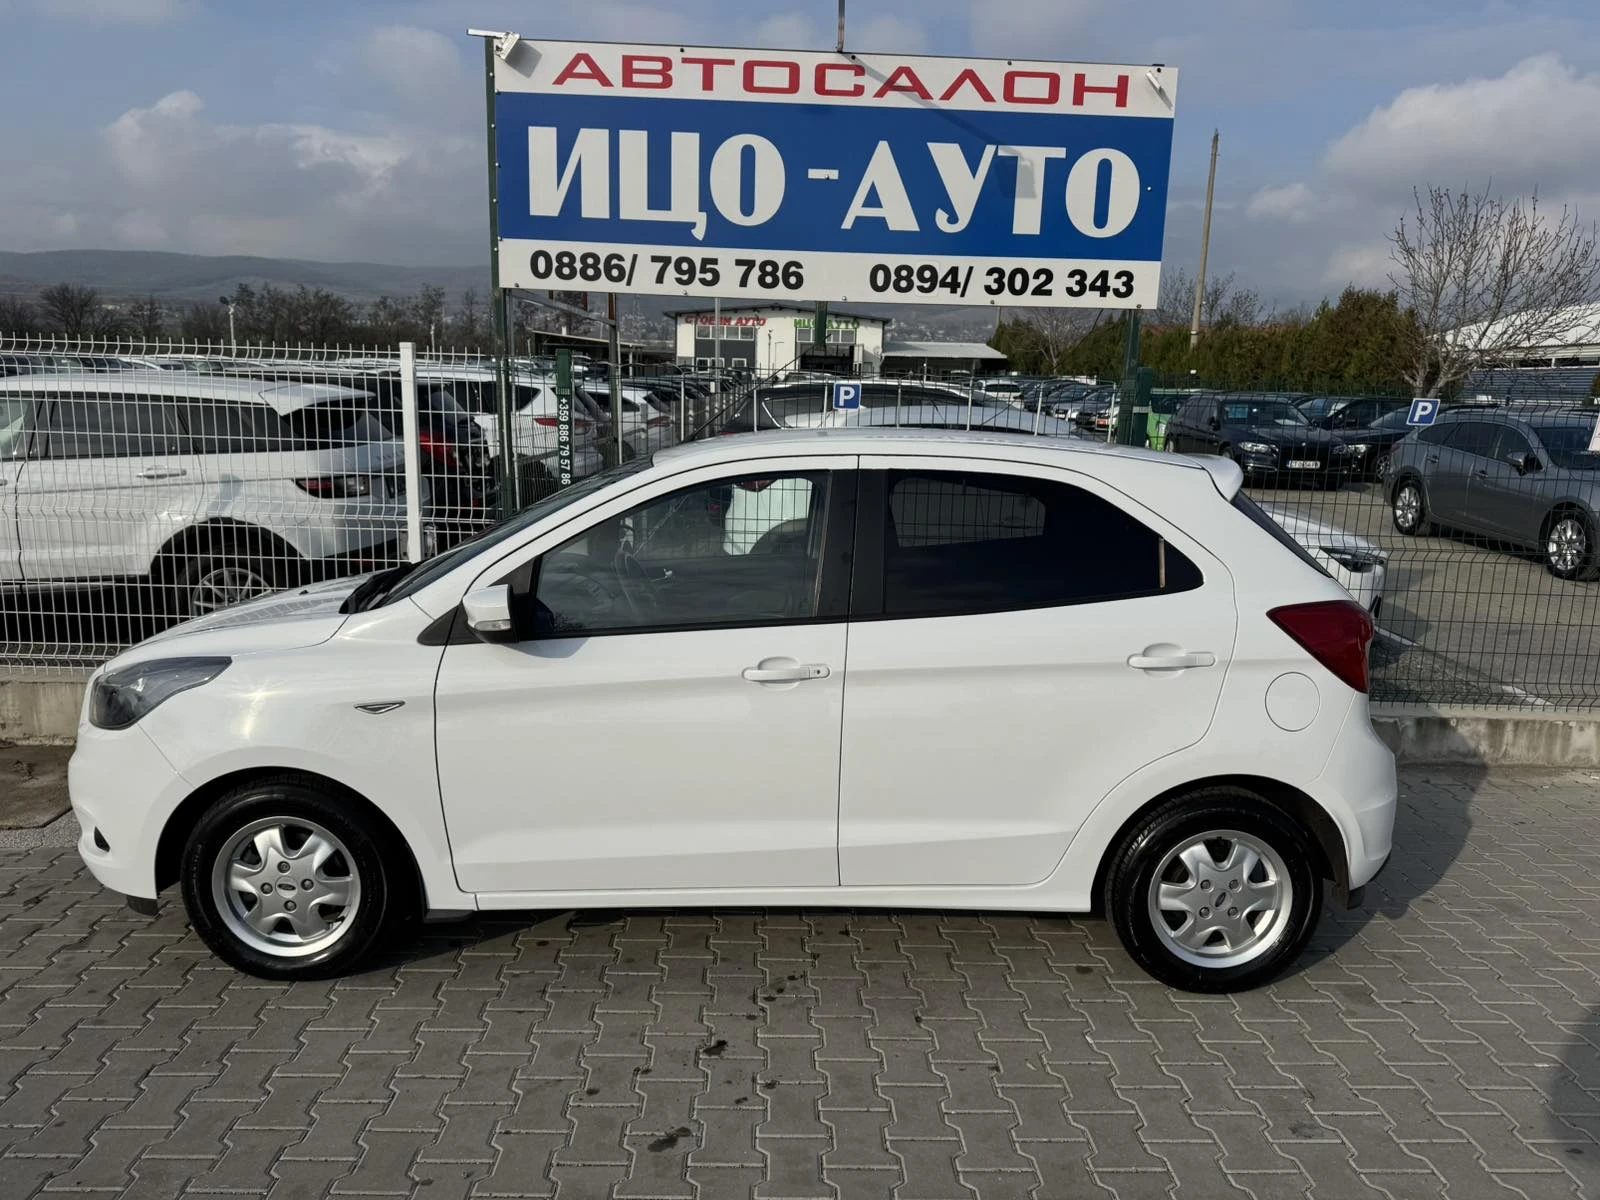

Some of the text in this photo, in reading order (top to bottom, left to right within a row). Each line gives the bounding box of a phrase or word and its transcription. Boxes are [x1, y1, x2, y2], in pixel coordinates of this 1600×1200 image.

[552, 52, 1129, 108] АВТОСАЛОН
[527, 125, 786, 240] ИЦО
[530, 249, 804, 290] 0886/ 795 786
[869, 263, 1135, 298] 0894/ 302 343
[735, 316, 768, 327] АУТО
[826, 319, 860, 329] АУТО
[839, 386, 855, 406] P
[1413, 402, 1432, 422] P
[559, 397, 571, 485] +359 886 79 57 86
